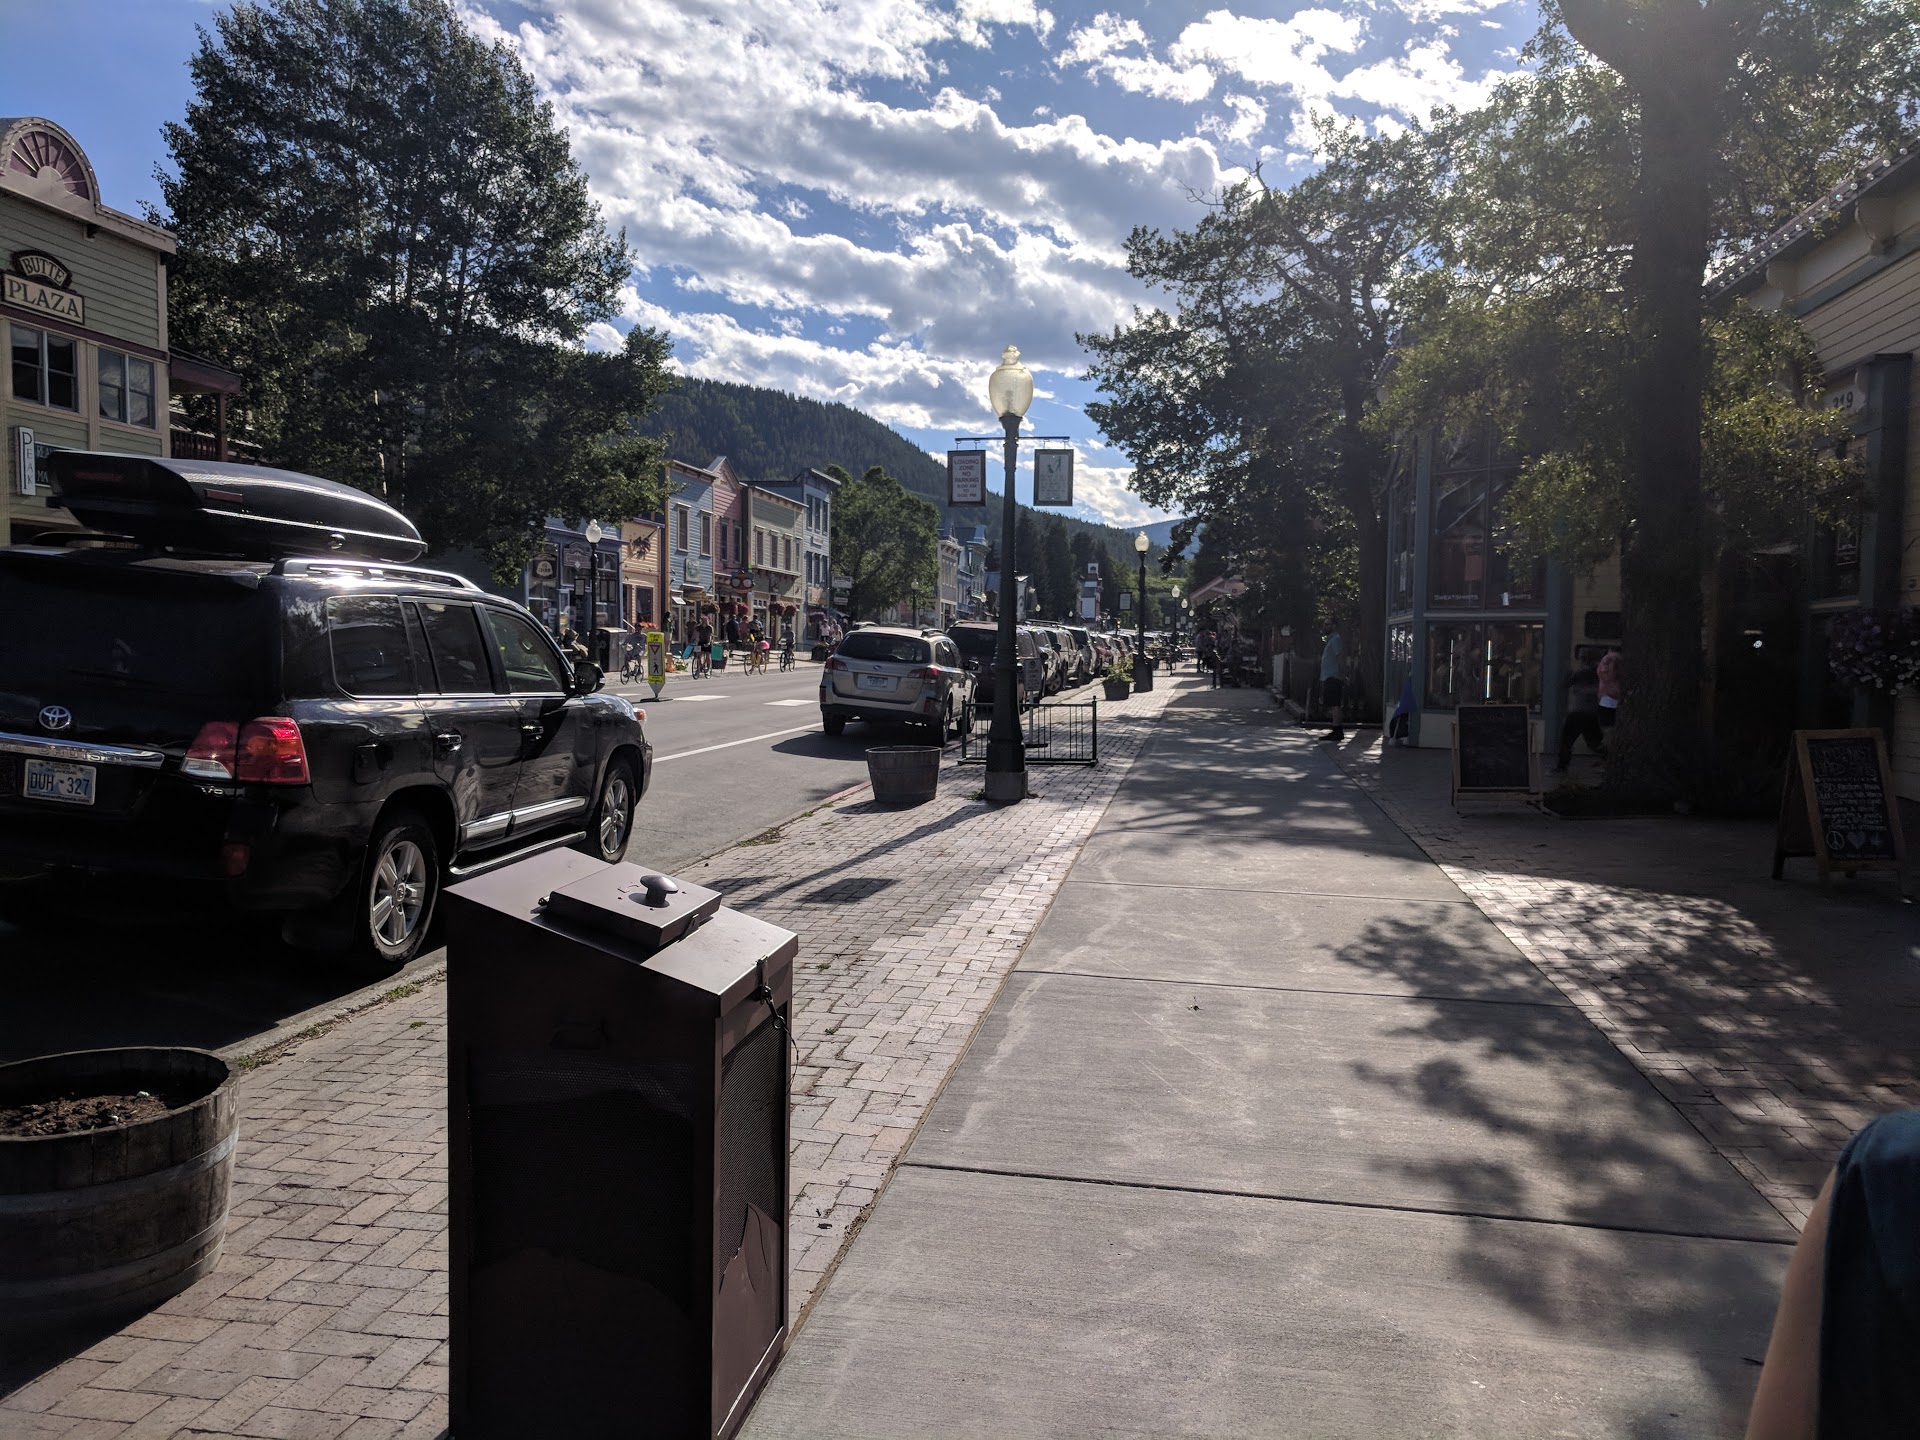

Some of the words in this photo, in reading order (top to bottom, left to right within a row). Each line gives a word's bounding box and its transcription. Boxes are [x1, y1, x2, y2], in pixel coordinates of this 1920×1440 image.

[22, 257, 65, 283] BUTTE
[8, 278, 81, 318] PLAZA
[22, 431, 34, 490] PEAK
